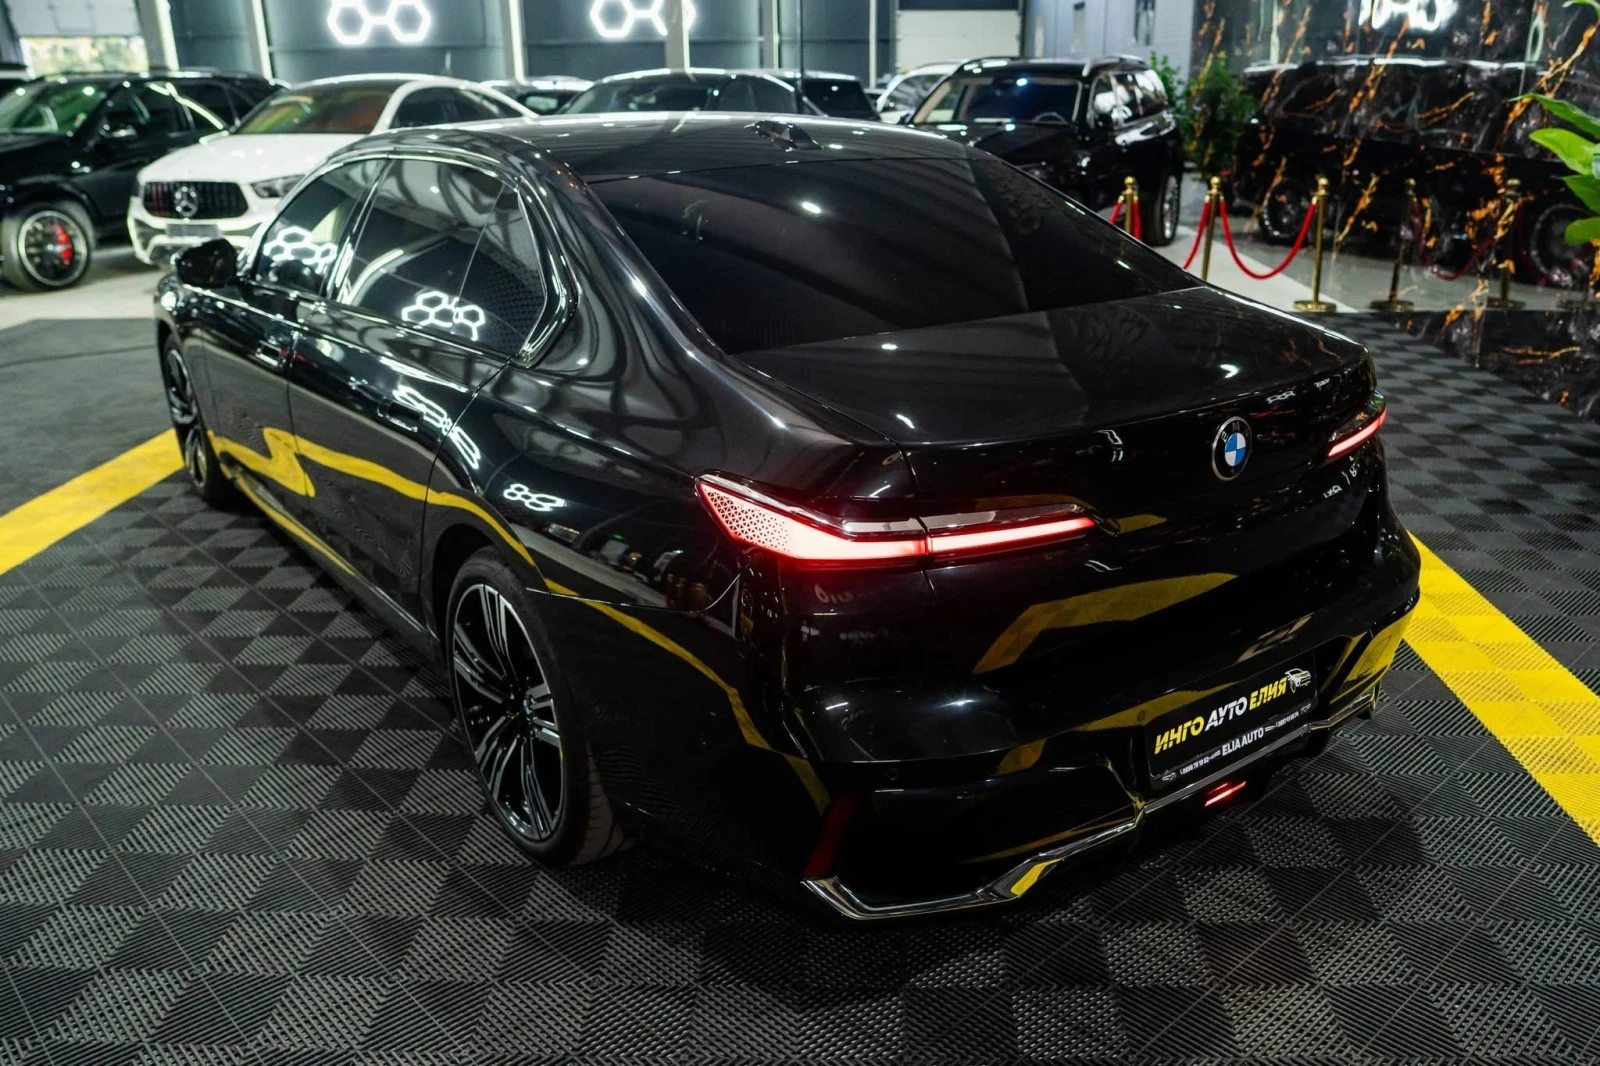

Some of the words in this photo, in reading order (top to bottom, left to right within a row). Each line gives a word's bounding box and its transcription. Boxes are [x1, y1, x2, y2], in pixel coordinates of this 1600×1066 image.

[1154, 716, 1205, 755] ИНГО
[1205, 696, 1248, 732] АУТО
[1249, 676, 1288, 711] ЕЛИЯ
[1221, 738, 1242, 757] ELIA
[1241, 726, 1264, 747] AUTO
